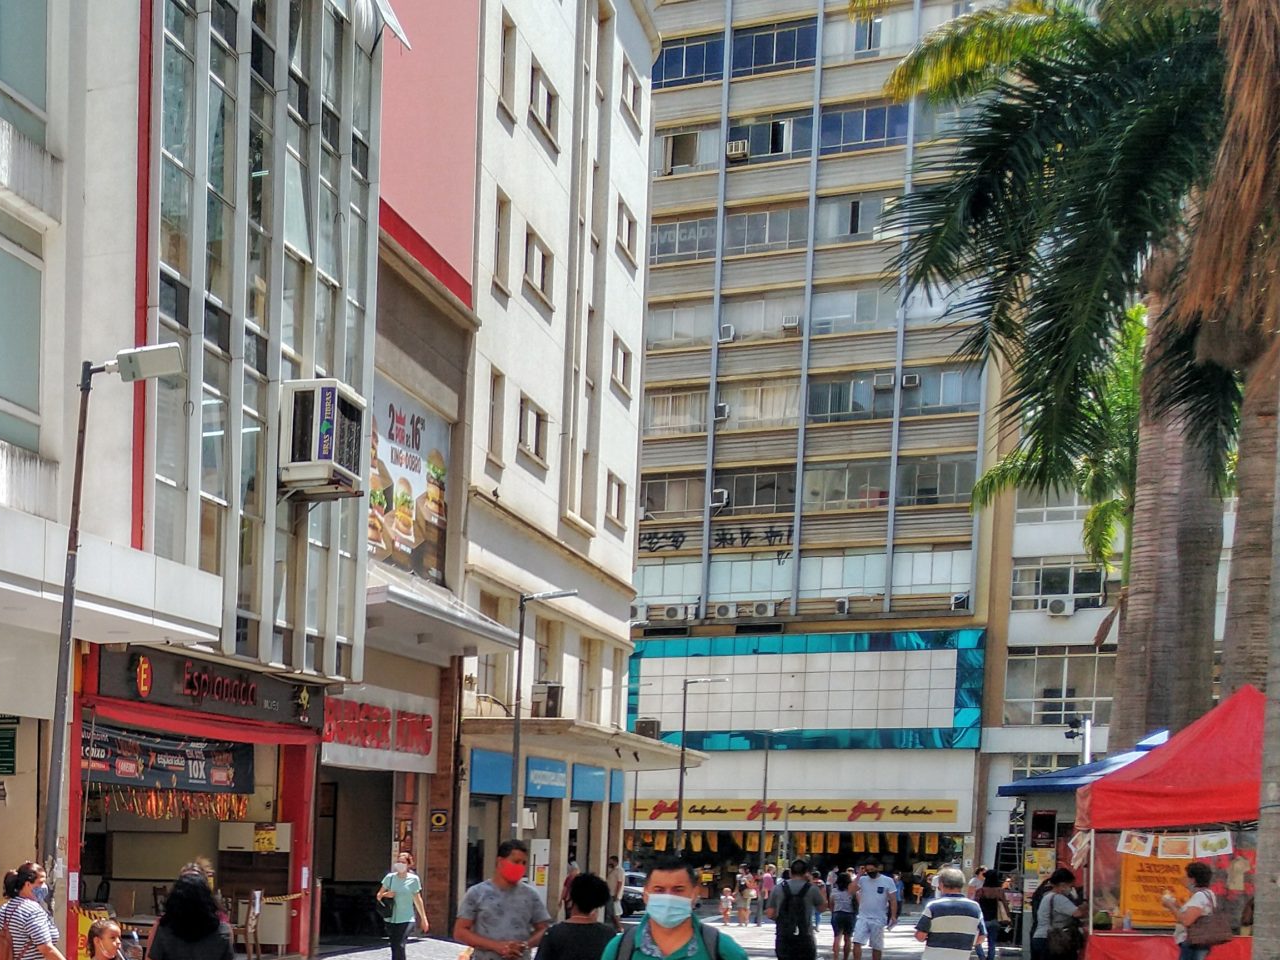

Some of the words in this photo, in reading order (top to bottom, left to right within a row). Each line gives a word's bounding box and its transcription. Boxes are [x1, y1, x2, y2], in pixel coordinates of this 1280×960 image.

[388, 403, 395, 441] 2
[396, 710, 433, 756] KING
[188, 760, 207, 780] 10X
